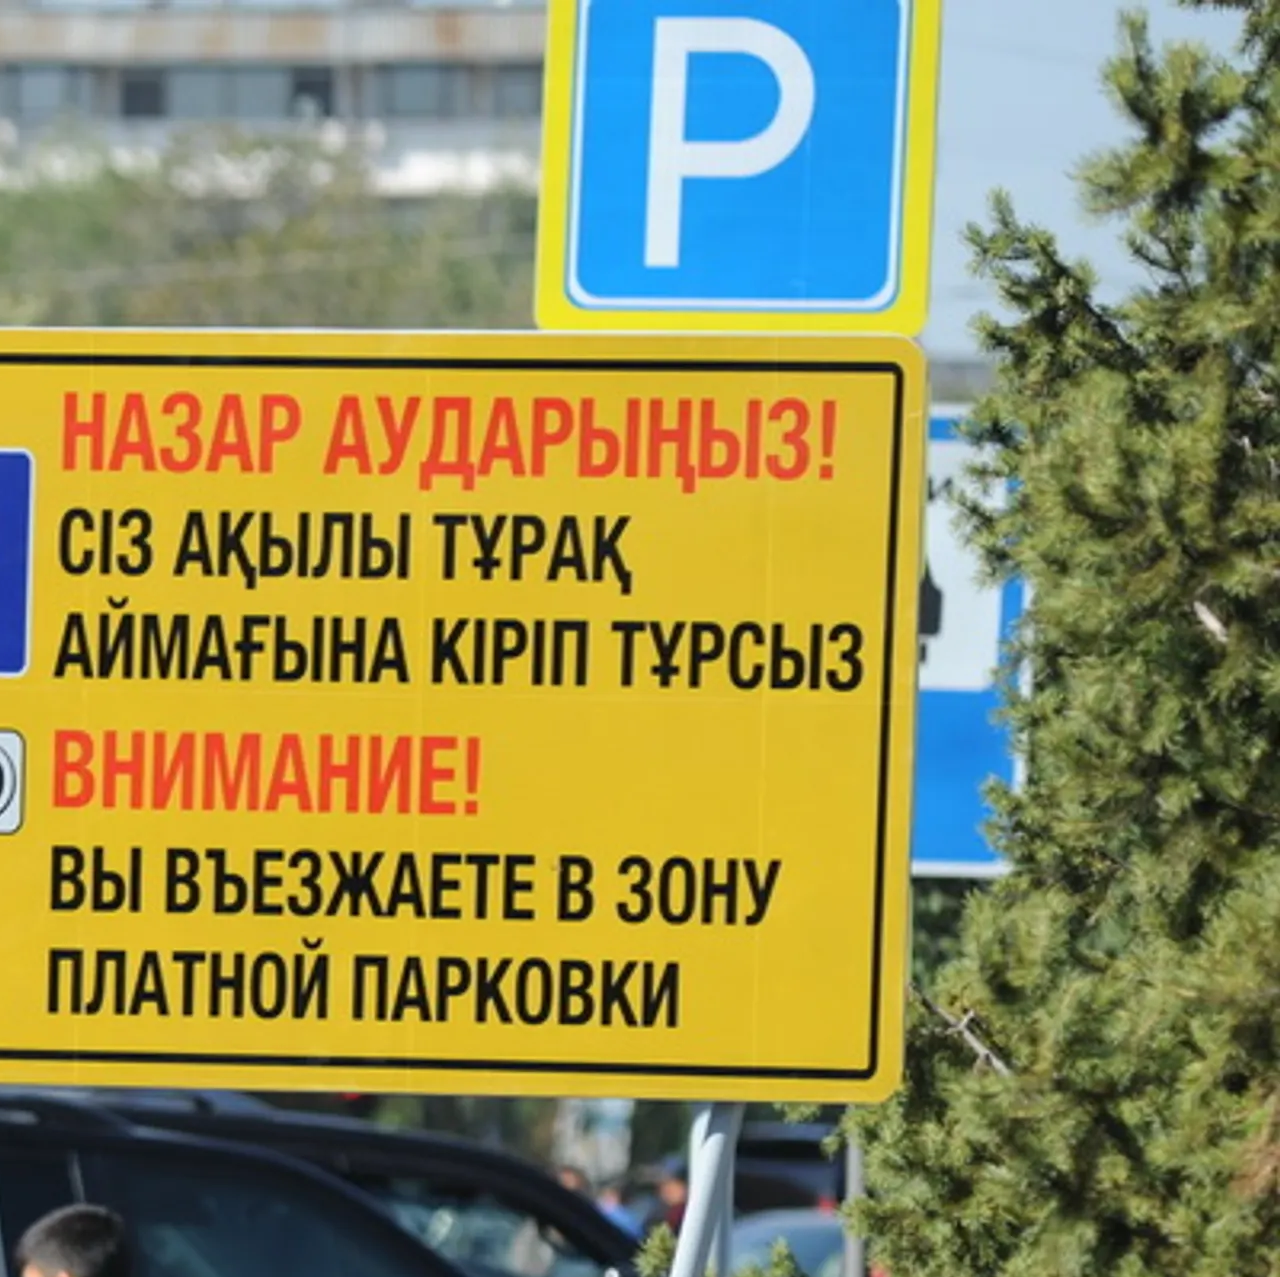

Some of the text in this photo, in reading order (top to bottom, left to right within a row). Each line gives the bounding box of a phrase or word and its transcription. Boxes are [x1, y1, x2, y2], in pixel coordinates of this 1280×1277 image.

[644, 16, 816, 267] P
[61, 391, 837, 494] НАЗАР АУДАРЫҢЫЗ!
[58, 508, 633, 595] СІЗ АҚЫЛЫ ТҰРАҚ
[53, 597, 864, 692] АЙМАҒЫНА КІРІП ТҰРСЫЗ
[51, 729, 481, 815] ВНИМАНИЕ!
[49, 845, 781, 926] ВЫ ВЪЕЗЖАЕТЕ В ЗОНУ
[47, 938, 680, 1029] ПЛАТНОЙ ПАРКОВКИ
